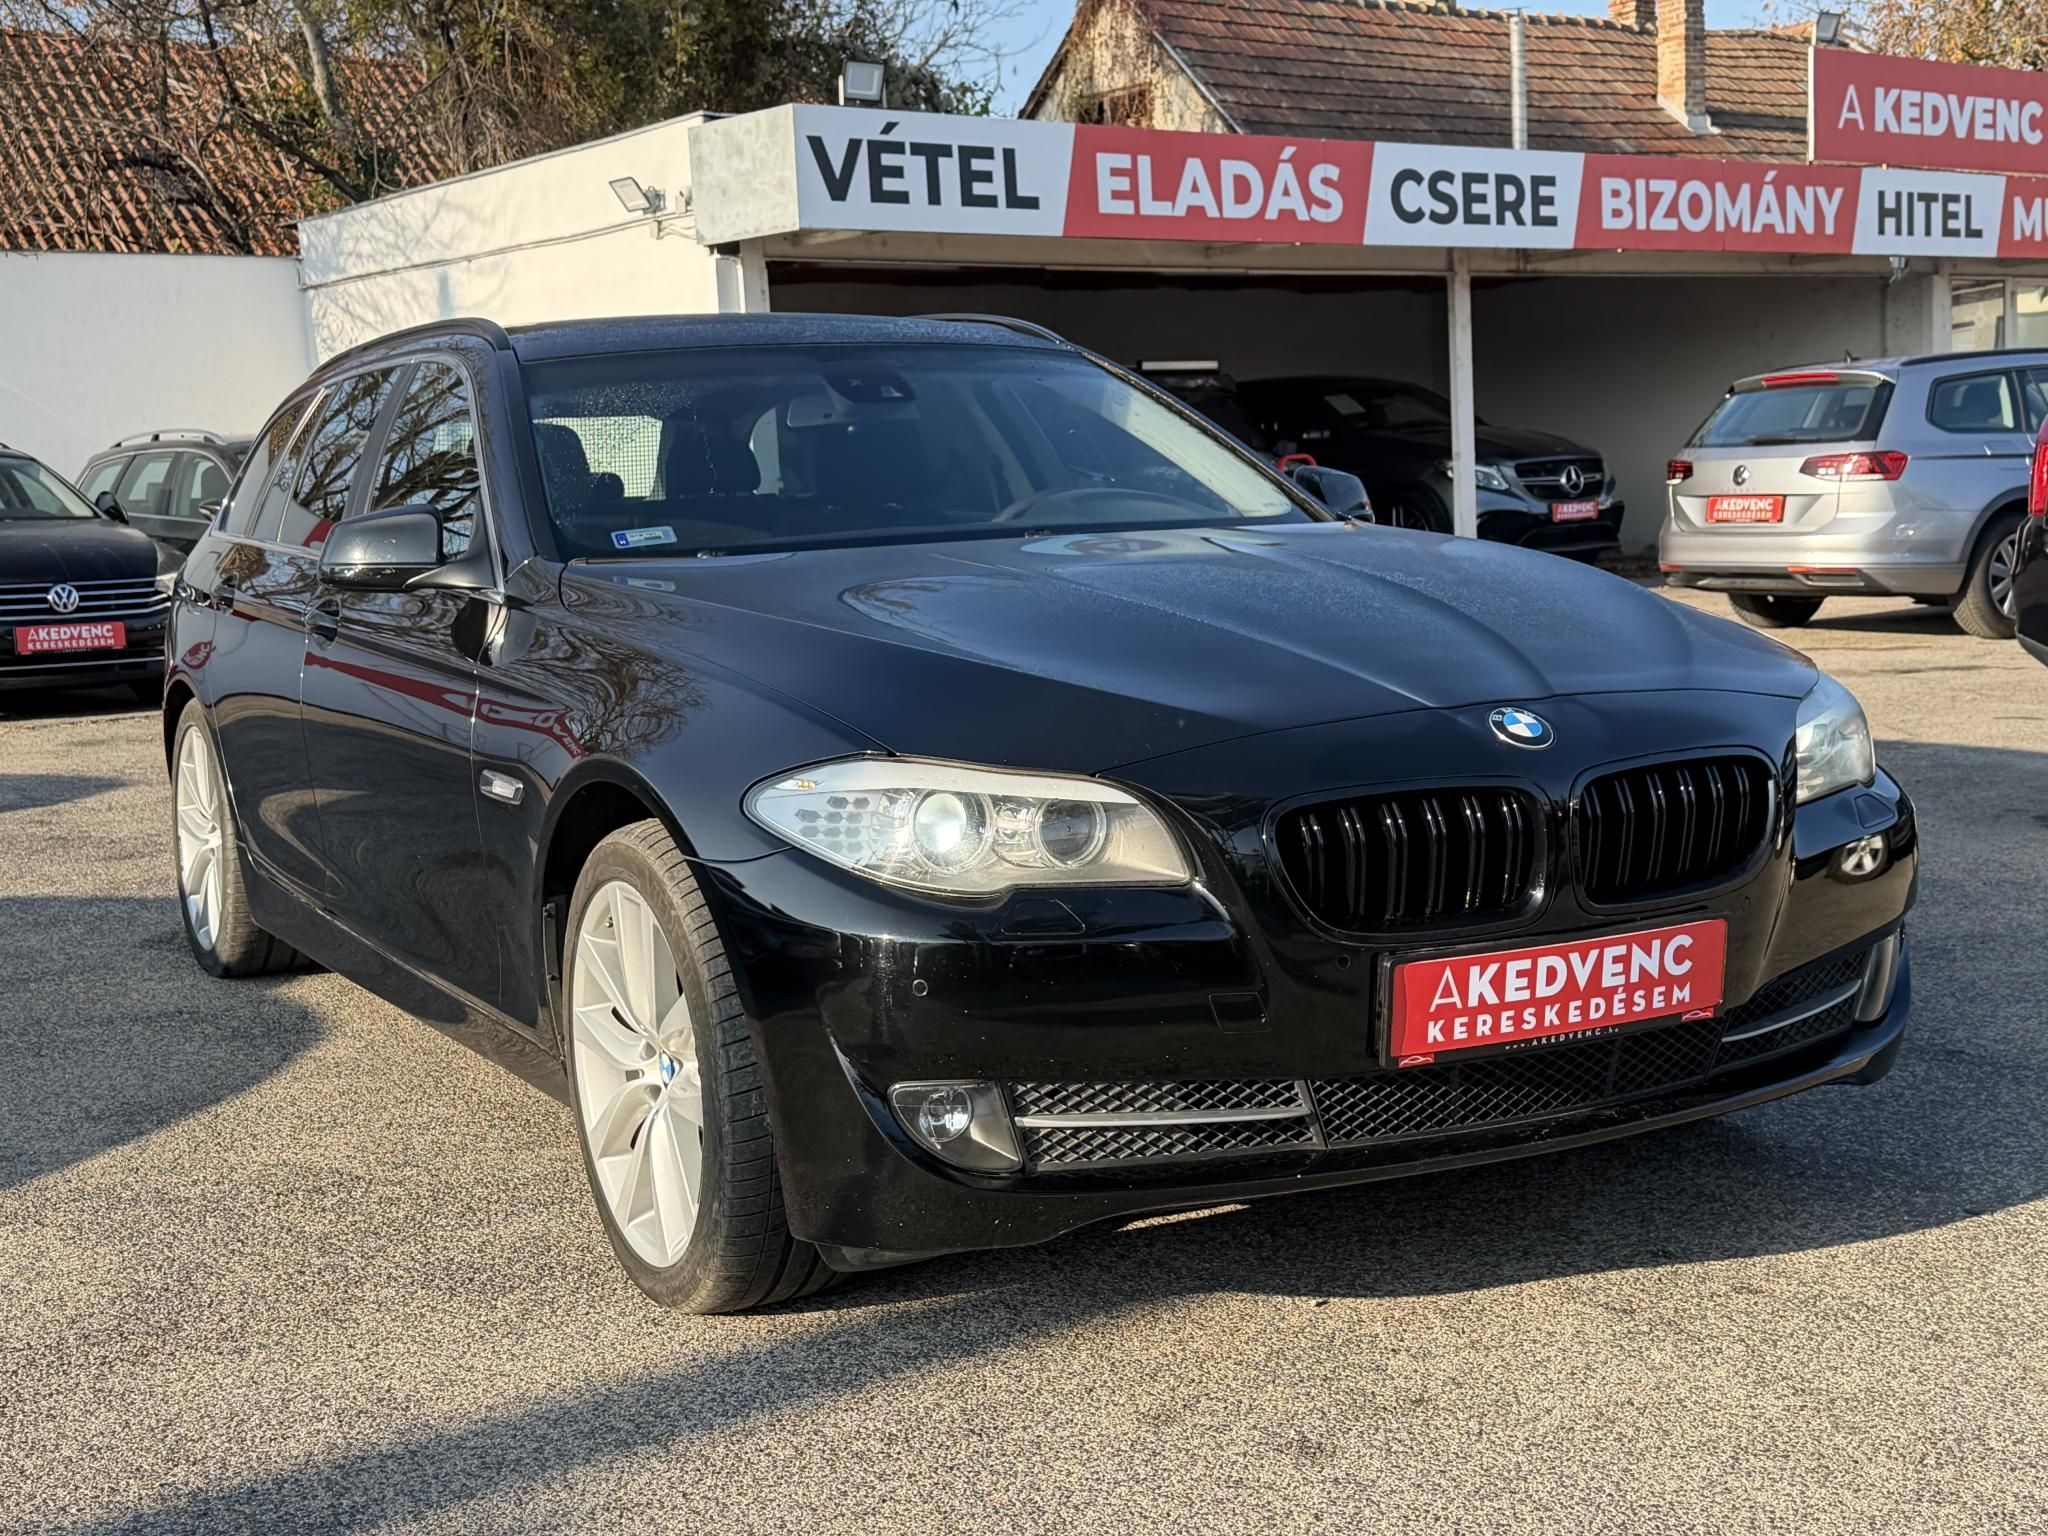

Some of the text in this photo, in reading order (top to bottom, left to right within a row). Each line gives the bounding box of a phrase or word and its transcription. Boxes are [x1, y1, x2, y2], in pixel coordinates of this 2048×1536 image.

[1838, 85, 2043, 145] A KEDVENC
[806, 121, 2048, 242] VÉTEL ELADÁS CSERE BIZOMÁNY HITEL M
[1427, 981, 1691, 1043] KERESKEDÉSEM
